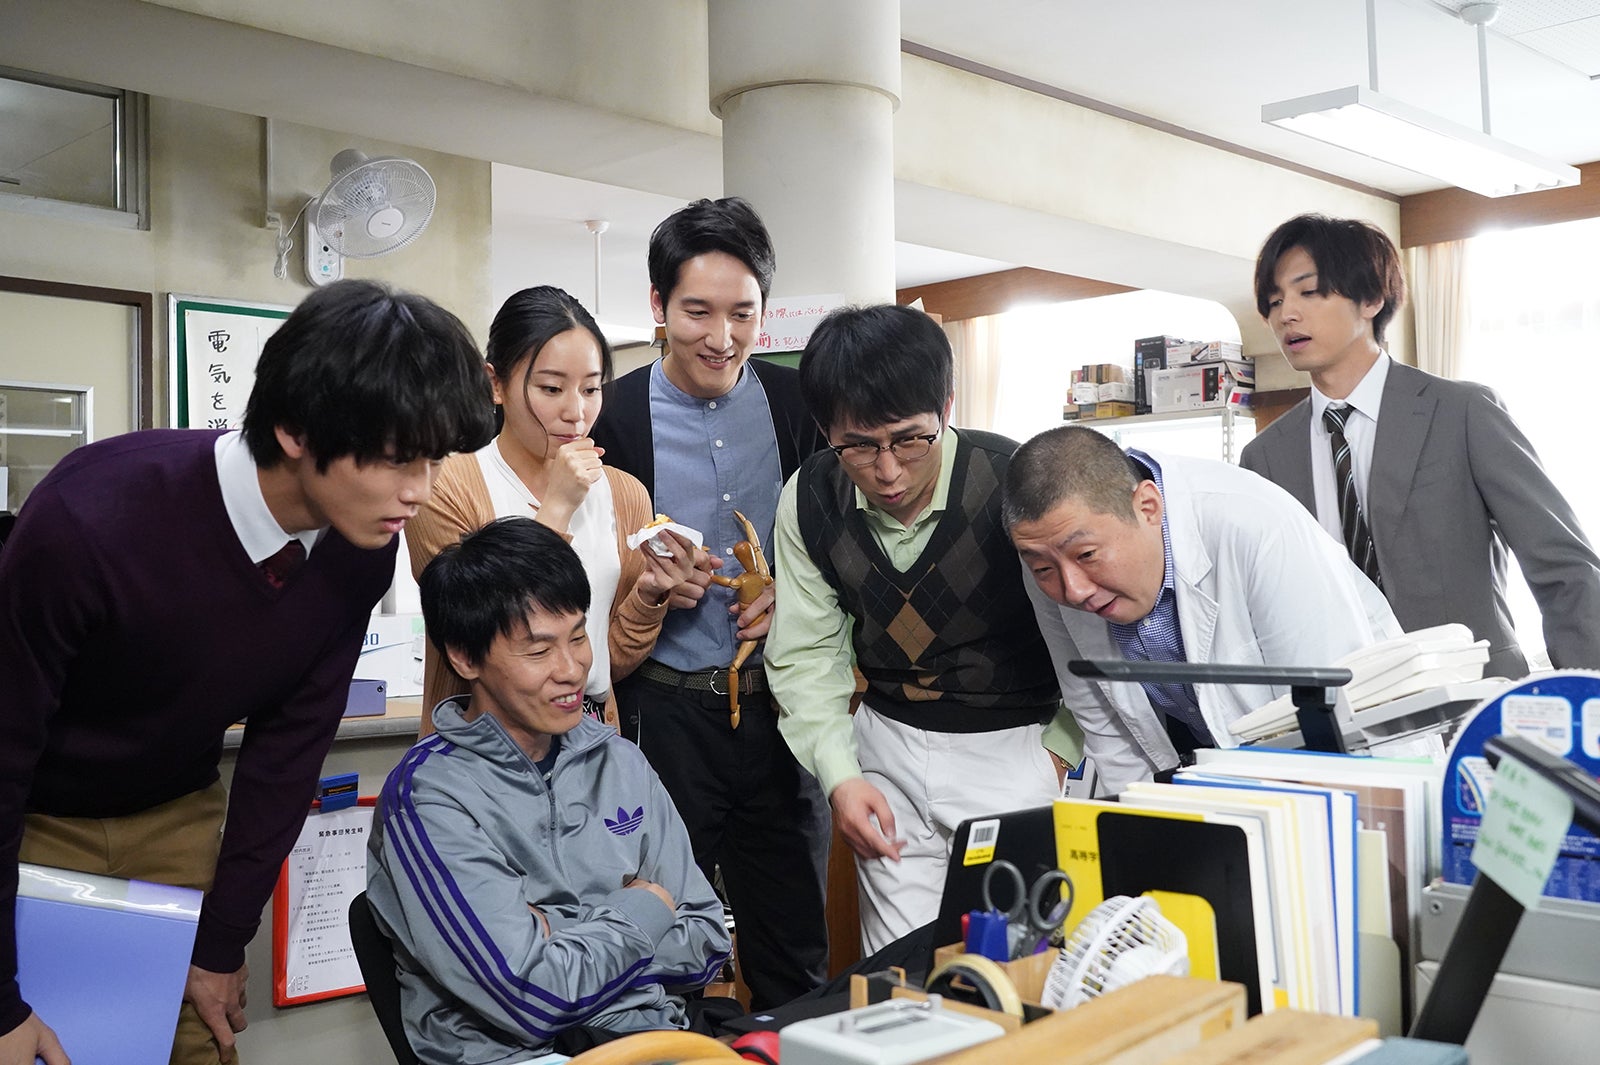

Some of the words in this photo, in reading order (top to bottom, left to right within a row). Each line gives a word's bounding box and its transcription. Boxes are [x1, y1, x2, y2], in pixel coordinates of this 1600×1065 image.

[755, 331, 810, 348] 前を記入し
